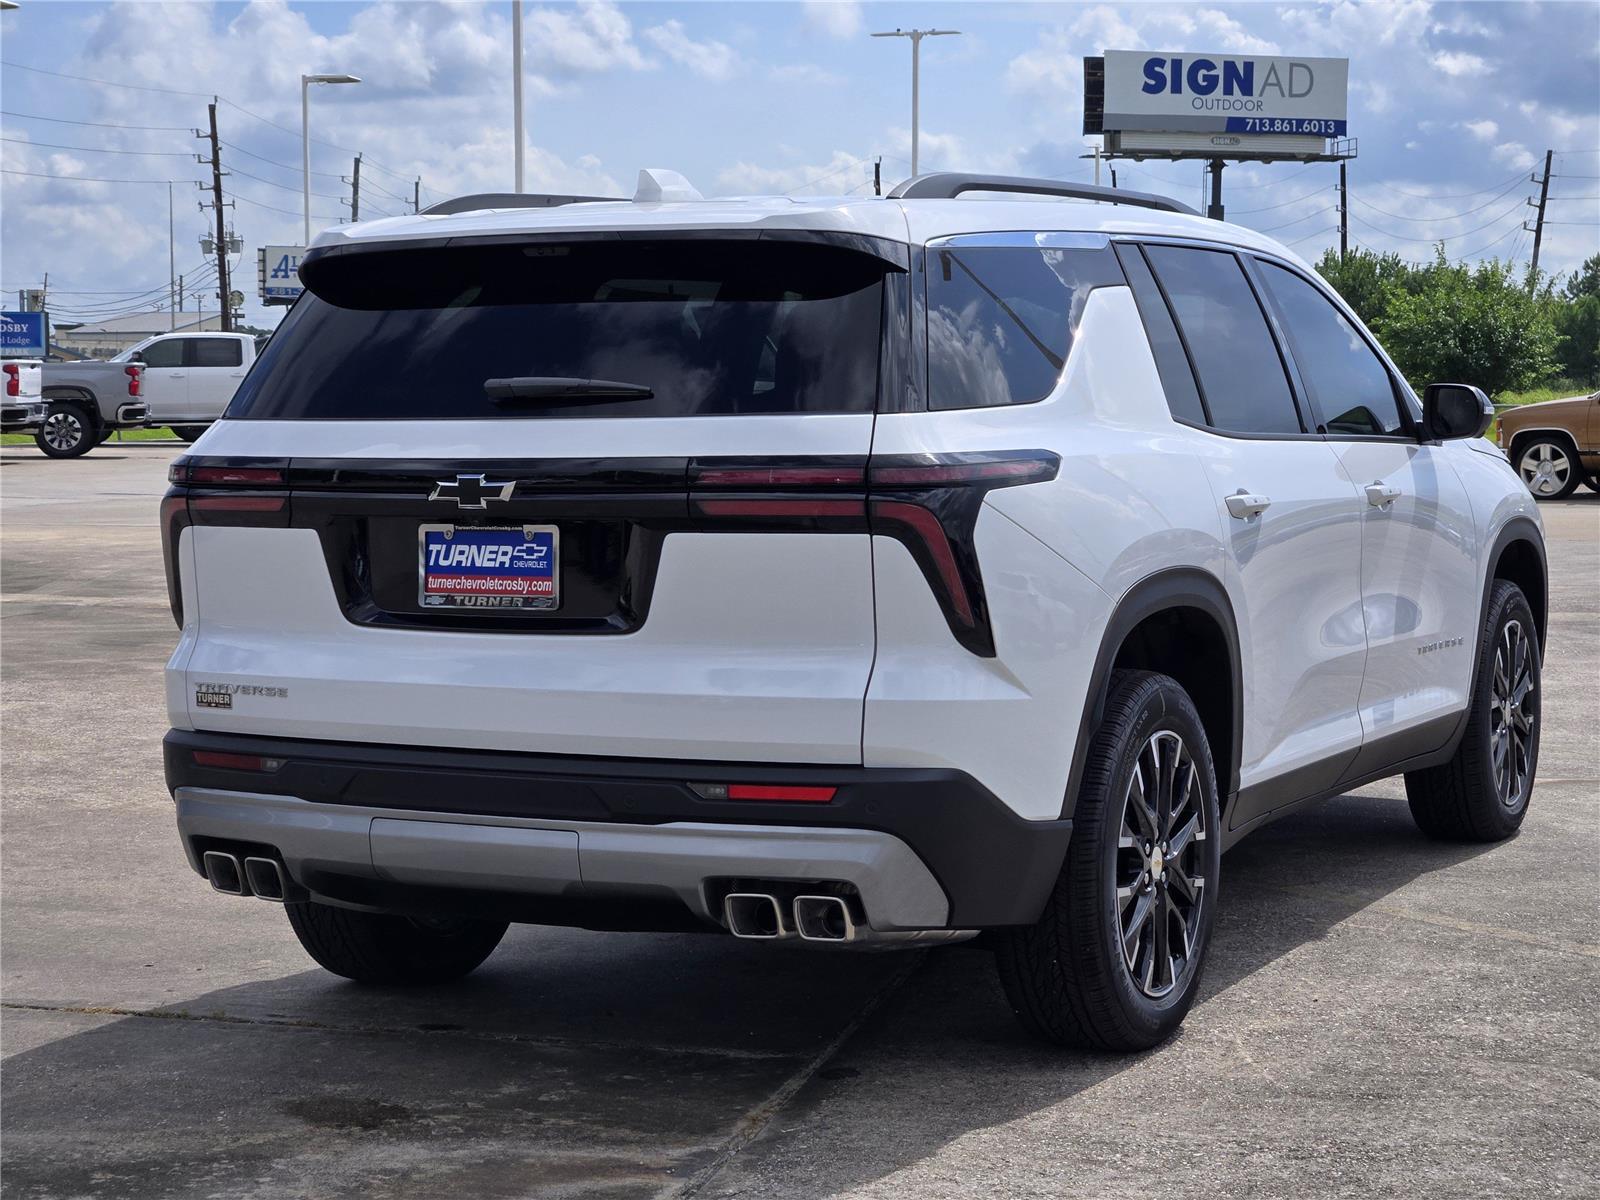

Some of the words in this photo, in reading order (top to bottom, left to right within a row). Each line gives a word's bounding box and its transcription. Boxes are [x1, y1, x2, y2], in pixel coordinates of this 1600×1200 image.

[1192, 97, 1264, 112] OUTDOOR
[1245, 119, 1335, 133] 713.861.6013
[7, 336, 31, 345] Lodge
[428, 544, 514, 568] TURNER
[513, 561, 547, 569] CHEVROLET
[428, 576, 552, 594] turnerchevroletcrosby.com
[454, 596, 524, 606] TURNER
[197, 693, 230, 704] TURNER
